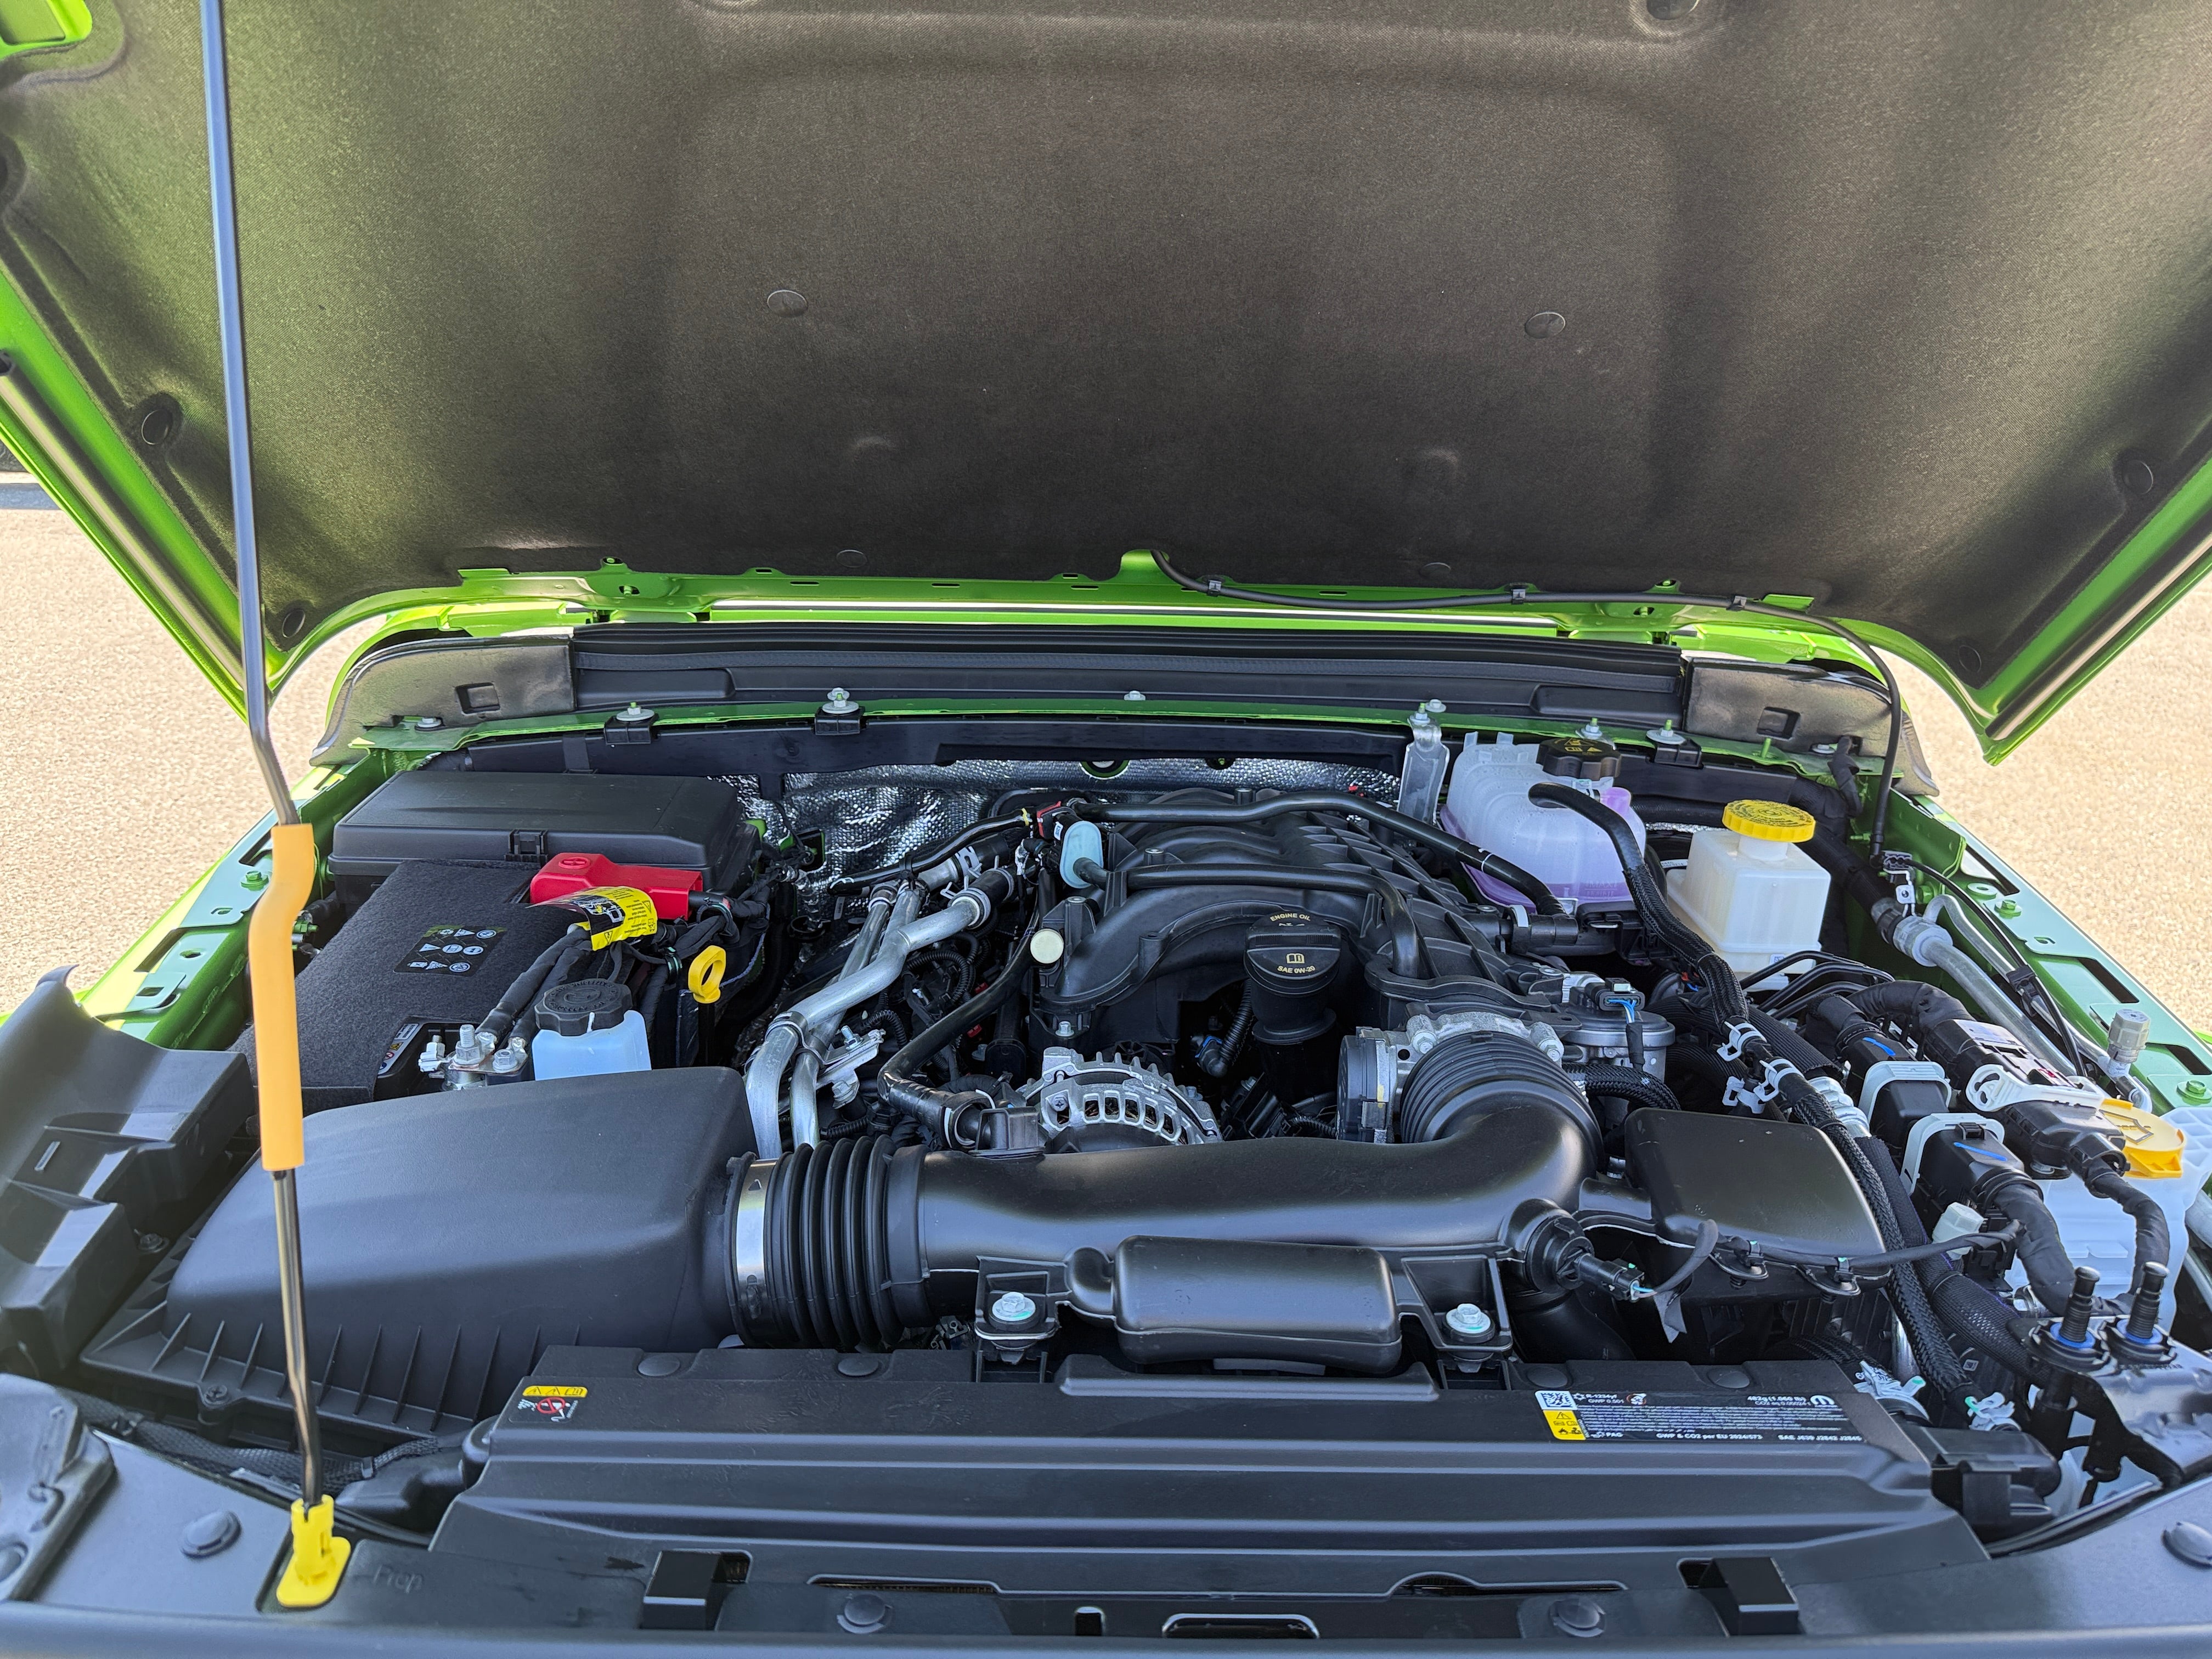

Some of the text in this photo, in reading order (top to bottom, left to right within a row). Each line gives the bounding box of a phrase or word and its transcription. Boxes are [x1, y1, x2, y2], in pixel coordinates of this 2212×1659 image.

[1270, 913, 1297, 922] ENGINE
[1277, 966, 1316, 974] SAE 0W-20
